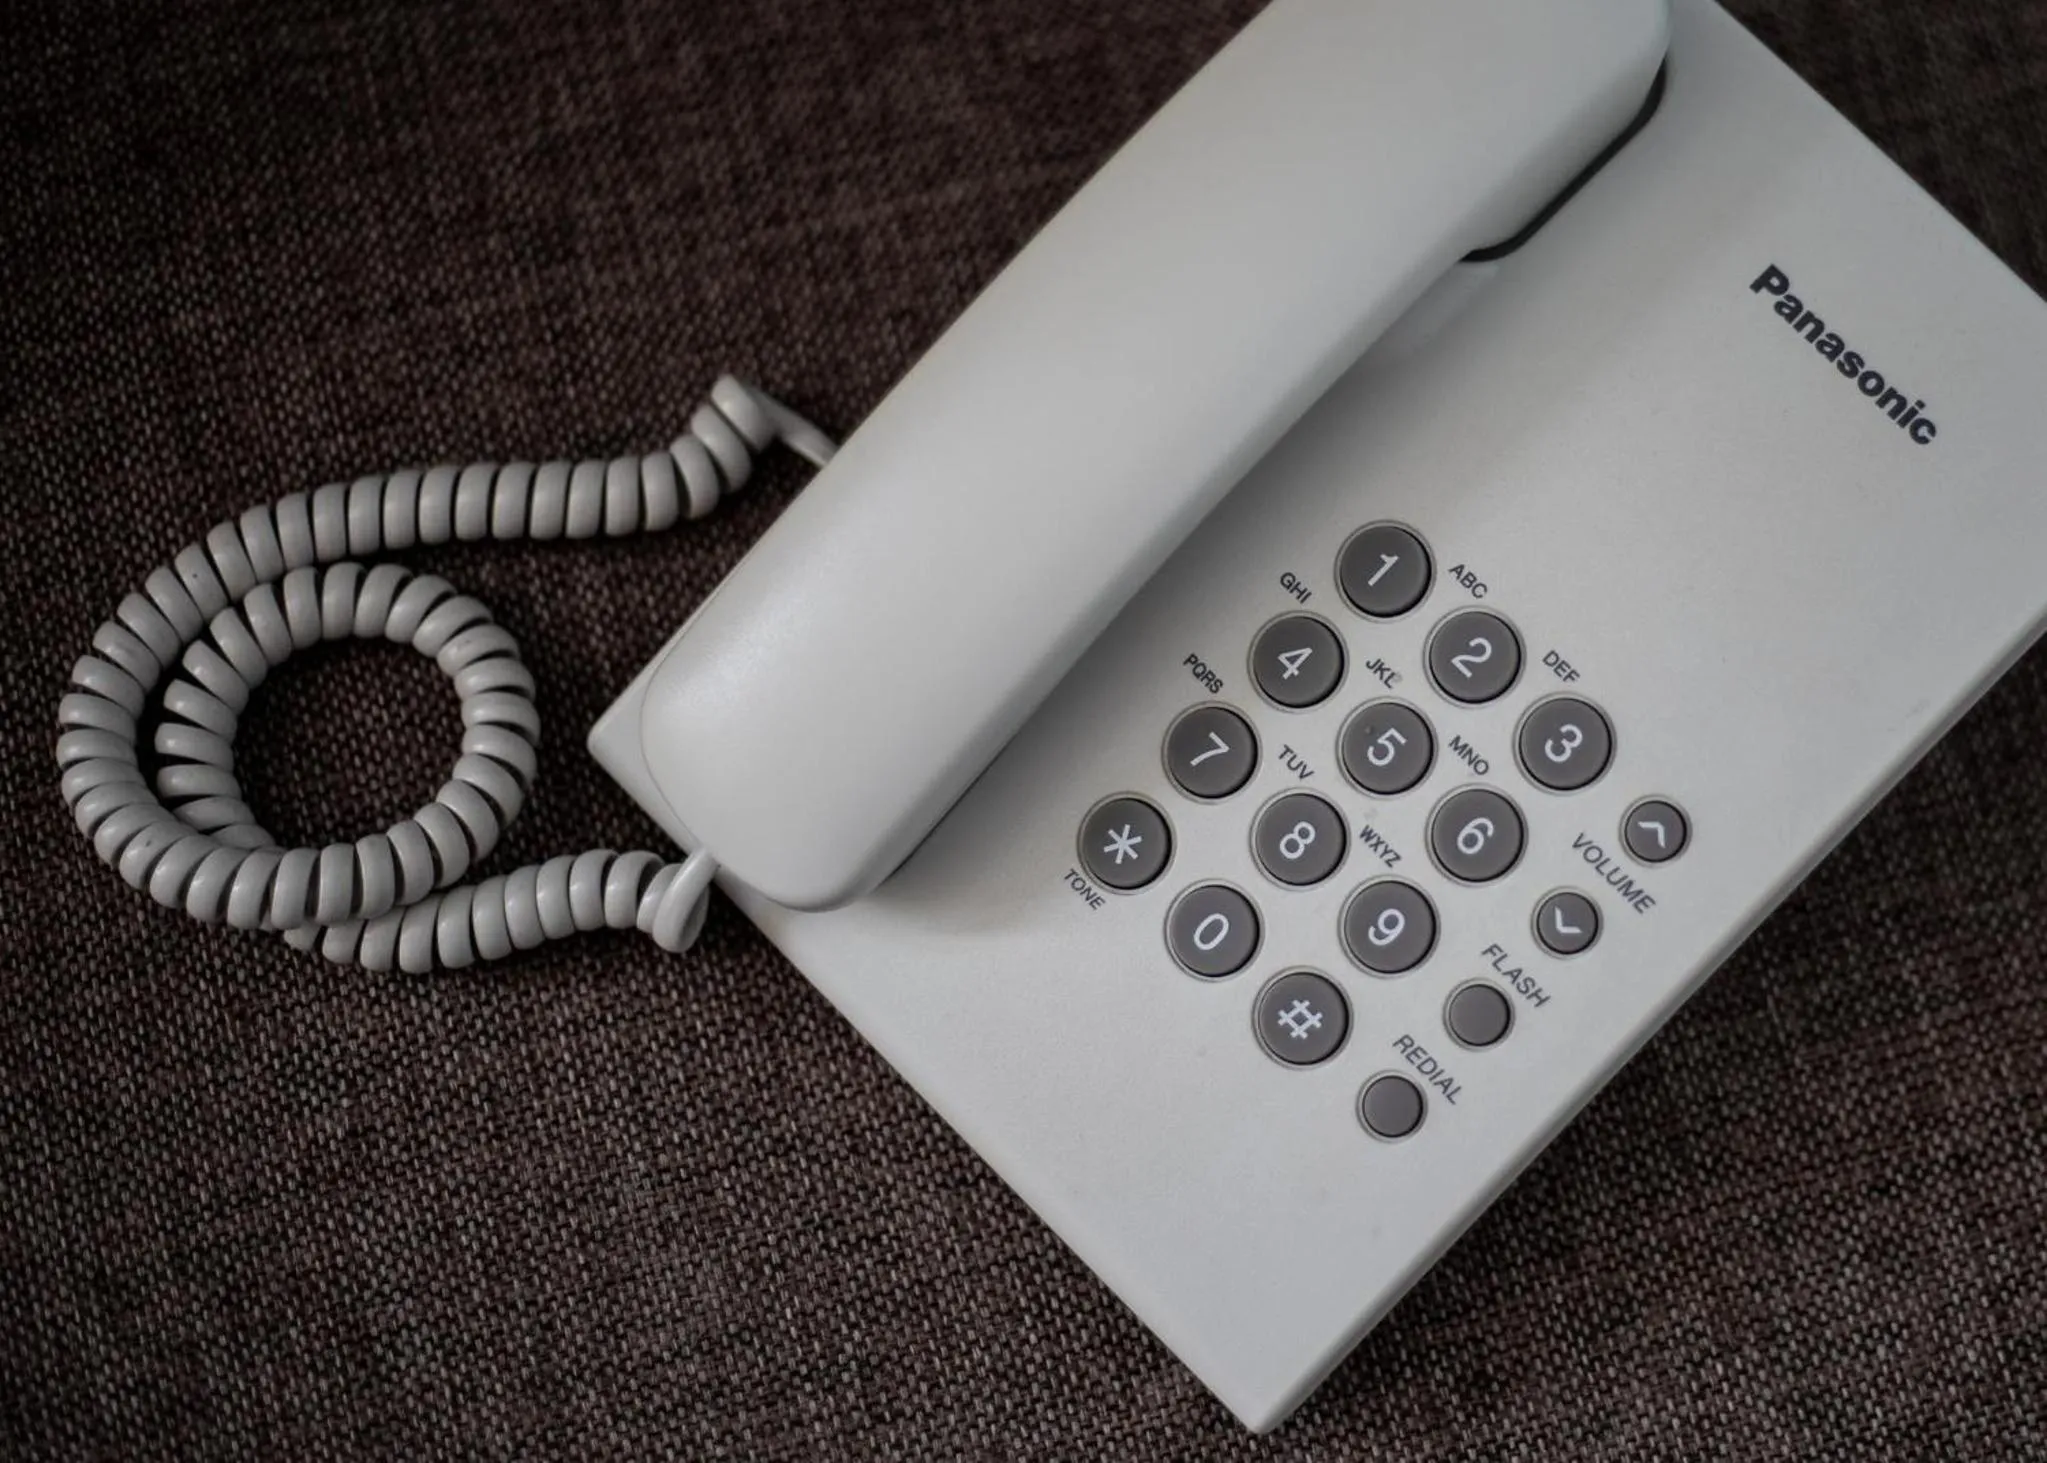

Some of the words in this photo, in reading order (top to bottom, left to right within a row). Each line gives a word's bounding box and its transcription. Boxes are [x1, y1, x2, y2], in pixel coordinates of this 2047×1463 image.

[1749, 264, 1937, 445] Panasonic
[1279, 572, 1312, 604] GHI
[1368, 553, 1399, 586] 1
[1448, 563, 1489, 599] ABC
[1183, 653, 1224, 694] PQRS
[1277, 647, 1313, 680] 4
[1366, 658, 1397, 688] JKL
[1451, 637, 1492, 678] 2
[1542, 650, 1581, 684] DEF
[1190, 731, 1230, 767] 7
[1278, 744, 1314, 780] TUV
[1367, 728, 1407, 766] 5
[1449, 735, 1489, 775] MNO
[1544, 724, 1583, 763] 3
[1280, 821, 1316, 859] 8
[1359, 824, 1401, 868] WXYZ
[1457, 817, 1494, 855] 6
[1064, 868, 1106, 911] TONE
[1572, 832, 1657, 915] VOLUME
[1193, 912, 1229, 950] 0
[1368, 908, 1405, 946] 9
[1481, 943, 1551, 1008] FLASH
[1277, 999, 1323, 1039] #
[1392, 1034, 1464, 1105] REDIAL
